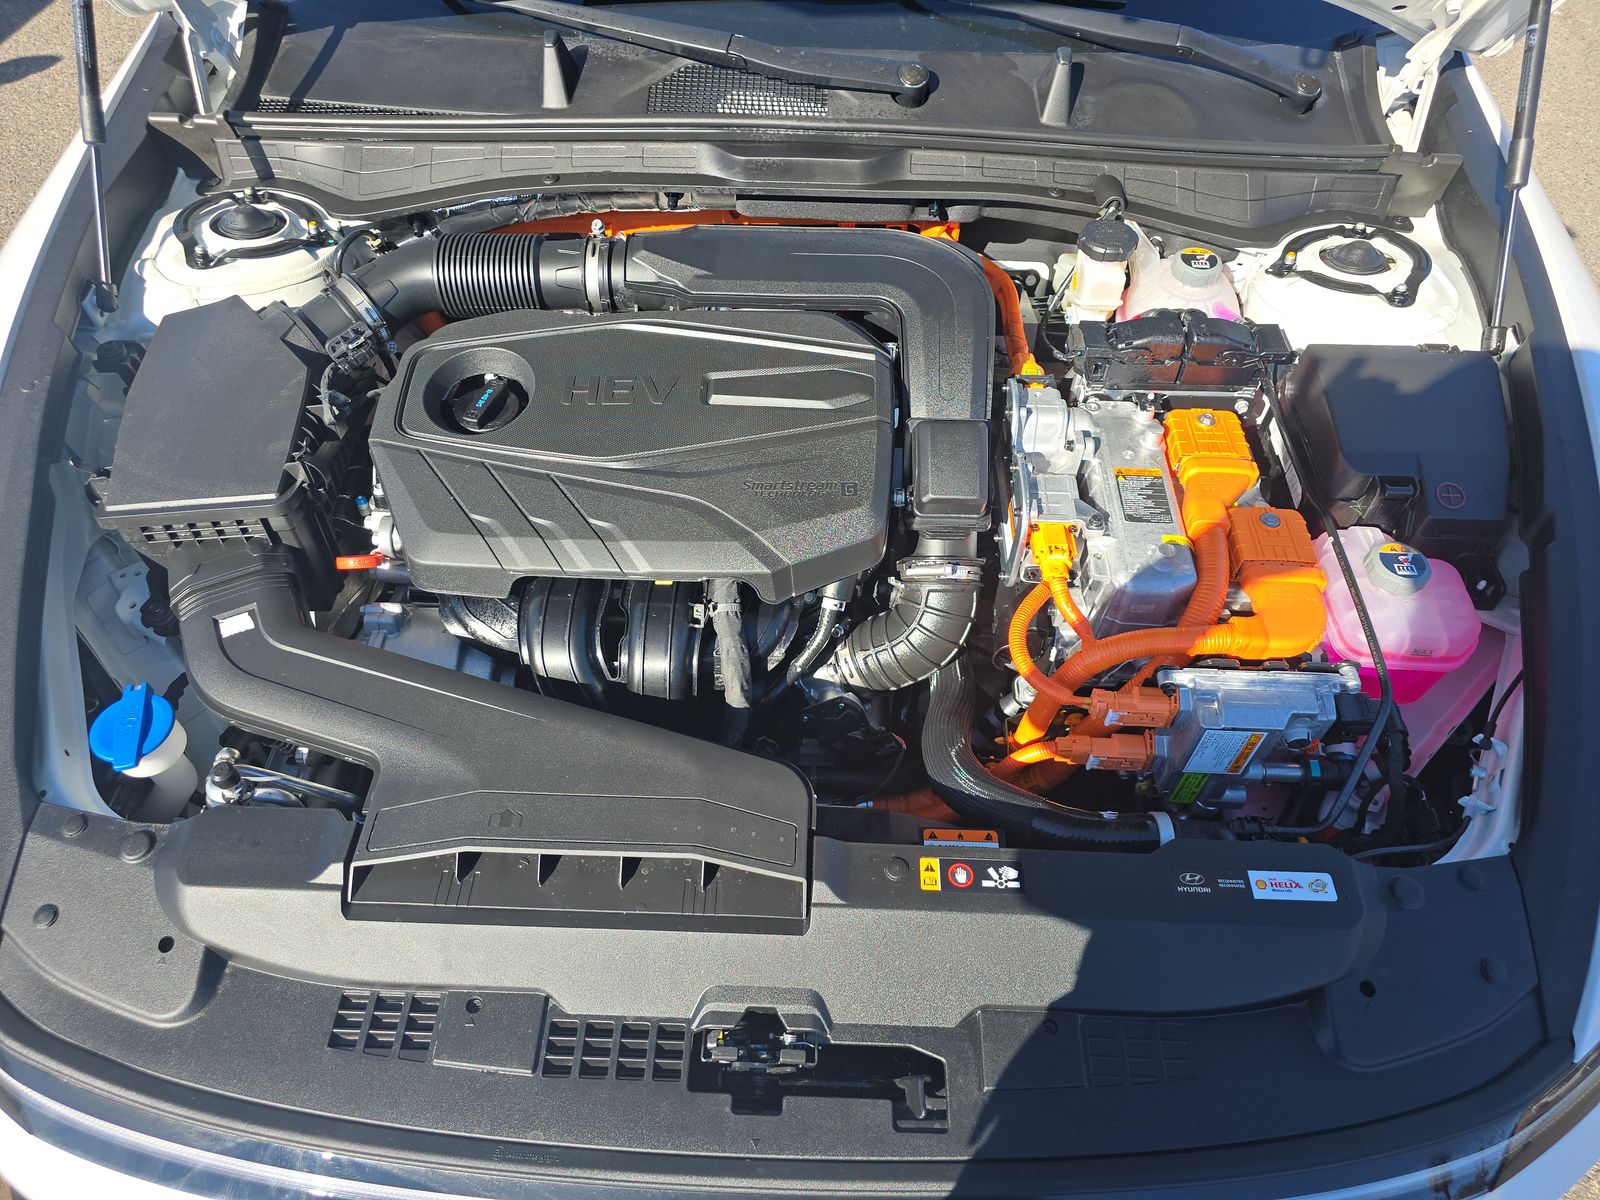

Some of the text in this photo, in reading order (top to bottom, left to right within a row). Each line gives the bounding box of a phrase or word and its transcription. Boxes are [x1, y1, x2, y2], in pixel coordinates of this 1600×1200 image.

[560, 376, 681, 405] HEV
[741, 480, 839, 491] Smartstream
[1270, 881, 1303, 889] HELIX
